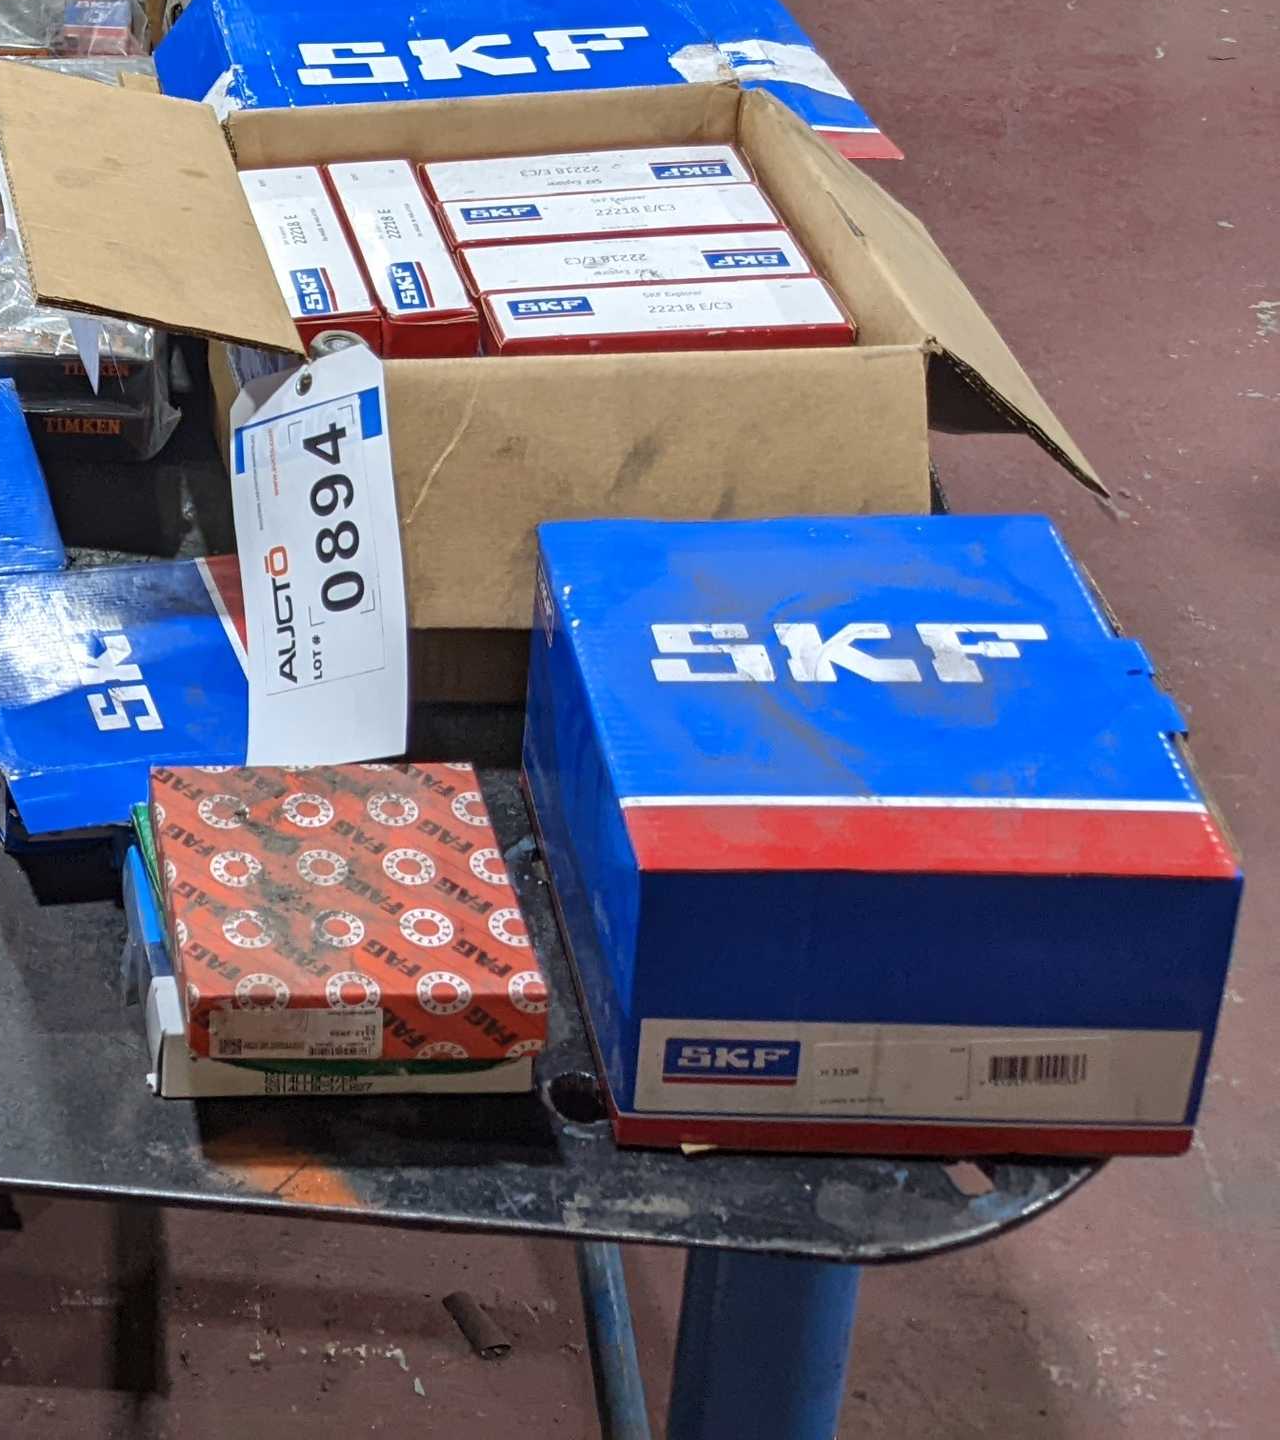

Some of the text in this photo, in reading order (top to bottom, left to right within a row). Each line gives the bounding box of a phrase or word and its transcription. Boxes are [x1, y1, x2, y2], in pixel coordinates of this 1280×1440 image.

[297, 25, 649, 86] SKF
[656, 164, 730, 178] SKF
[463, 204, 536, 219] SKF
[594, 204, 677, 217] 22218 E/C3
[290, 222, 308, 246] 22218
[385, 217, 403, 241] 22218
[714, 250, 785, 266] SKF
[297, 268, 328, 314] SKF
[393, 262, 423, 310] SKF
[510, 298, 587, 315] SKF
[647, 301, 734, 314] 22218 E/C3
[44, 418, 121, 435] TIMKEN
[302, 421, 366, 613] 0894
[311, 633, 324, 681] LOT #
[650, 622, 1048, 683] SKF
[154, 767, 203, 801] FAG
[165, 823, 216, 857] FAG
[332, 819, 386, 855] FAG
[417, 819, 474, 855] FAG
[434, 876, 494, 914] FAG
[188, 942, 240, 981] FAG
[362, 938, 422, 978] FAG
[452, 938, 513, 978] FAG
[464, 1006, 519, 1048] FAG
[677, 1044, 791, 1069] SKF
